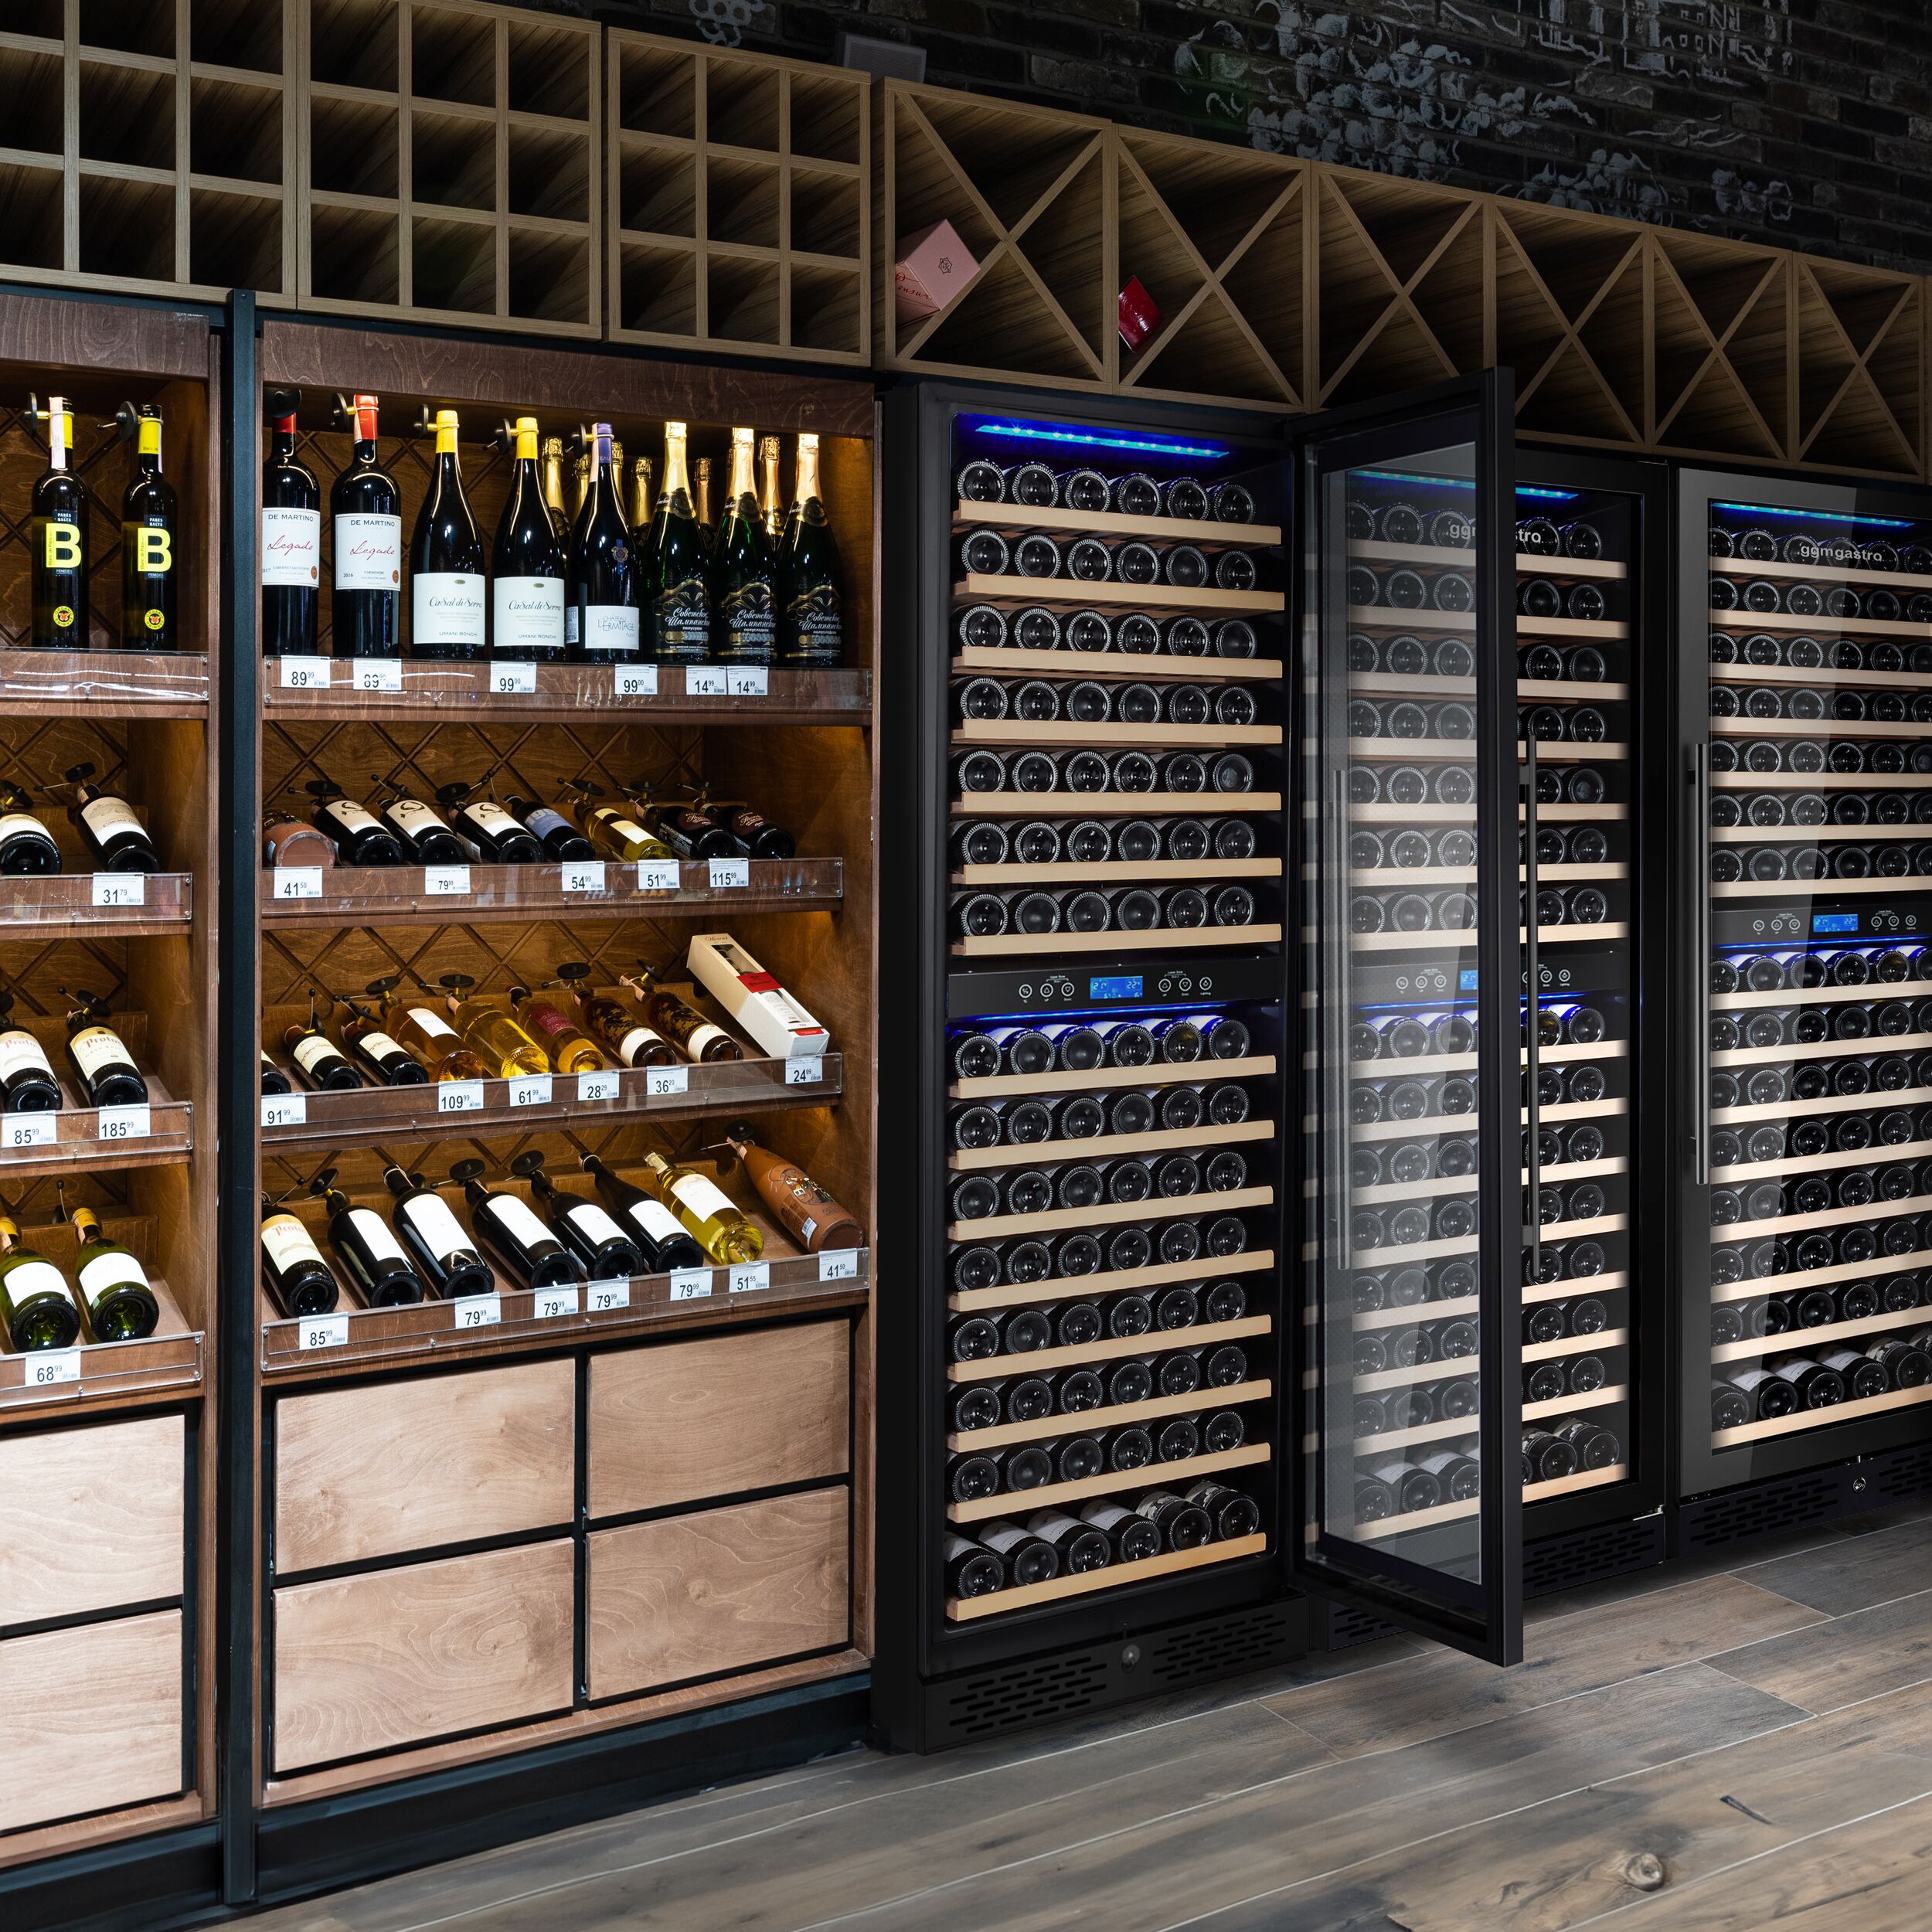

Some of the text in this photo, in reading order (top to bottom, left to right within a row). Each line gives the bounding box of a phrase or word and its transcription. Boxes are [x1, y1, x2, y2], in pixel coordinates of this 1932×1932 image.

[46, 522, 82, 568] B
[138, 527, 172, 572] B
[267, 535, 314, 556] Legado
[349, 540, 395, 561] Legado
